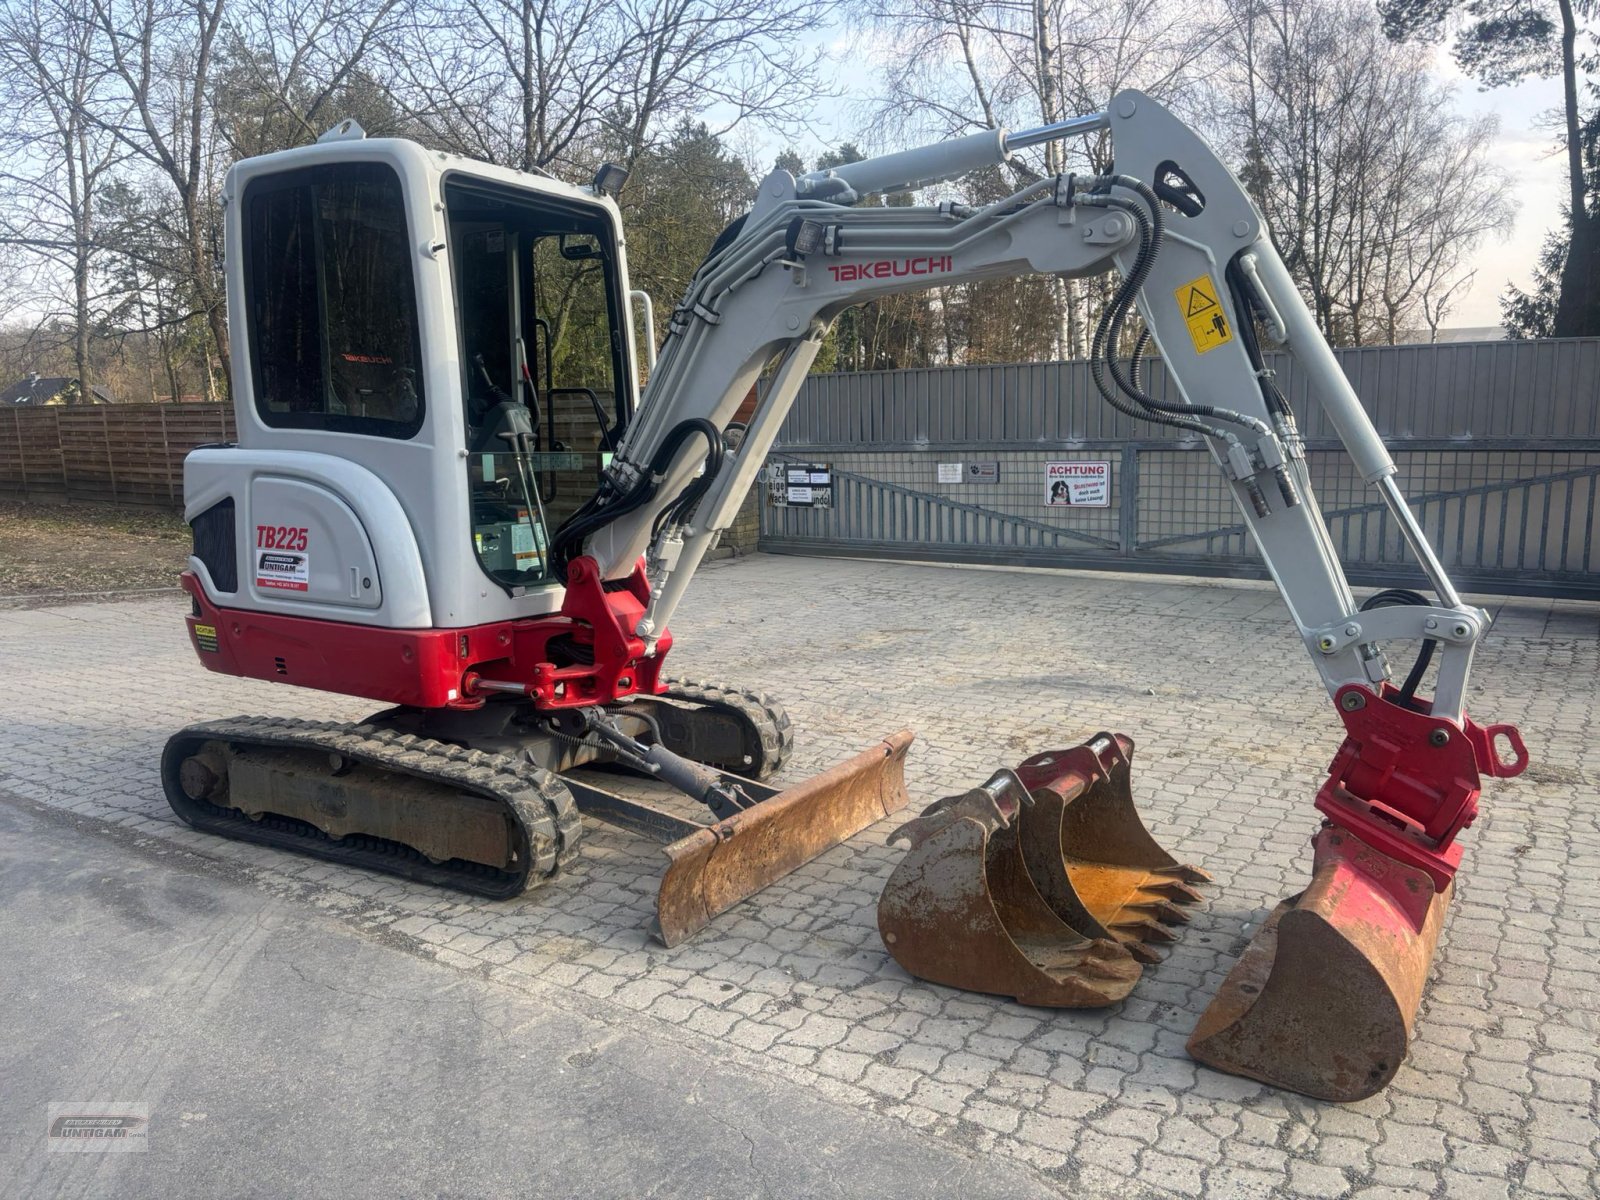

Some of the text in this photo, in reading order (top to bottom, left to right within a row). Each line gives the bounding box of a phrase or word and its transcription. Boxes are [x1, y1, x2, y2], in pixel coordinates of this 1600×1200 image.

[828, 256, 952, 282] TAKEUCHI
[1049, 466, 1104, 475] ACHTUNG
[257, 526, 308, 551] TB225
